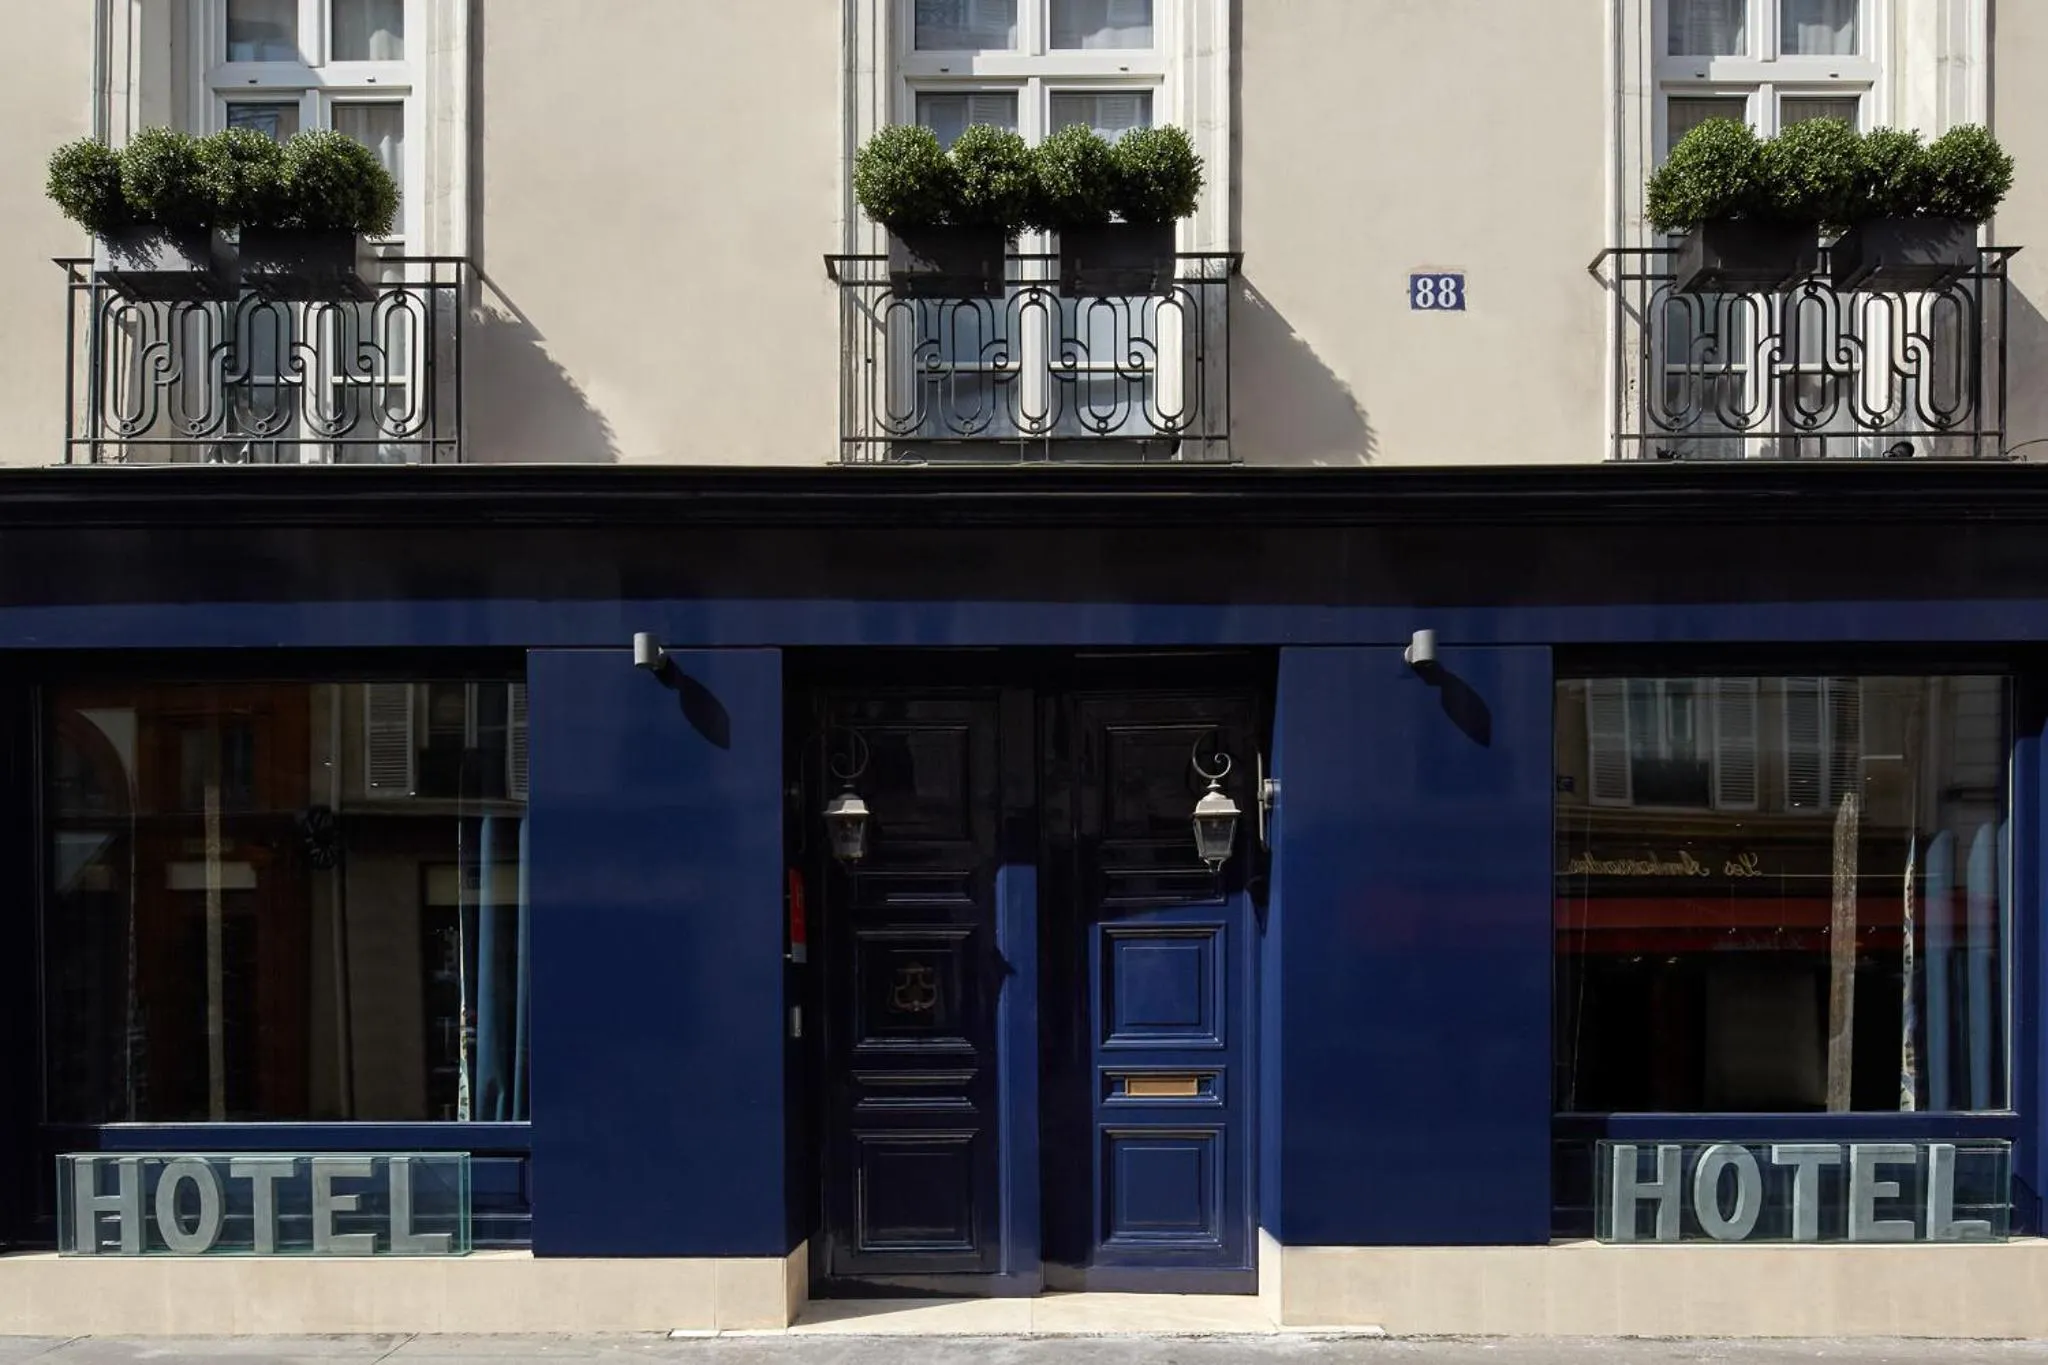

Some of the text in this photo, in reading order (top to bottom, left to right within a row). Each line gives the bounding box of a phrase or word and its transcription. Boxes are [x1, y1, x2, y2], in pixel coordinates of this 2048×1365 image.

[1415, 277, 1457, 308] 88
[74, 1156, 453, 1254] HOTEL
[1612, 1143, 1991, 1241] HOTEL
